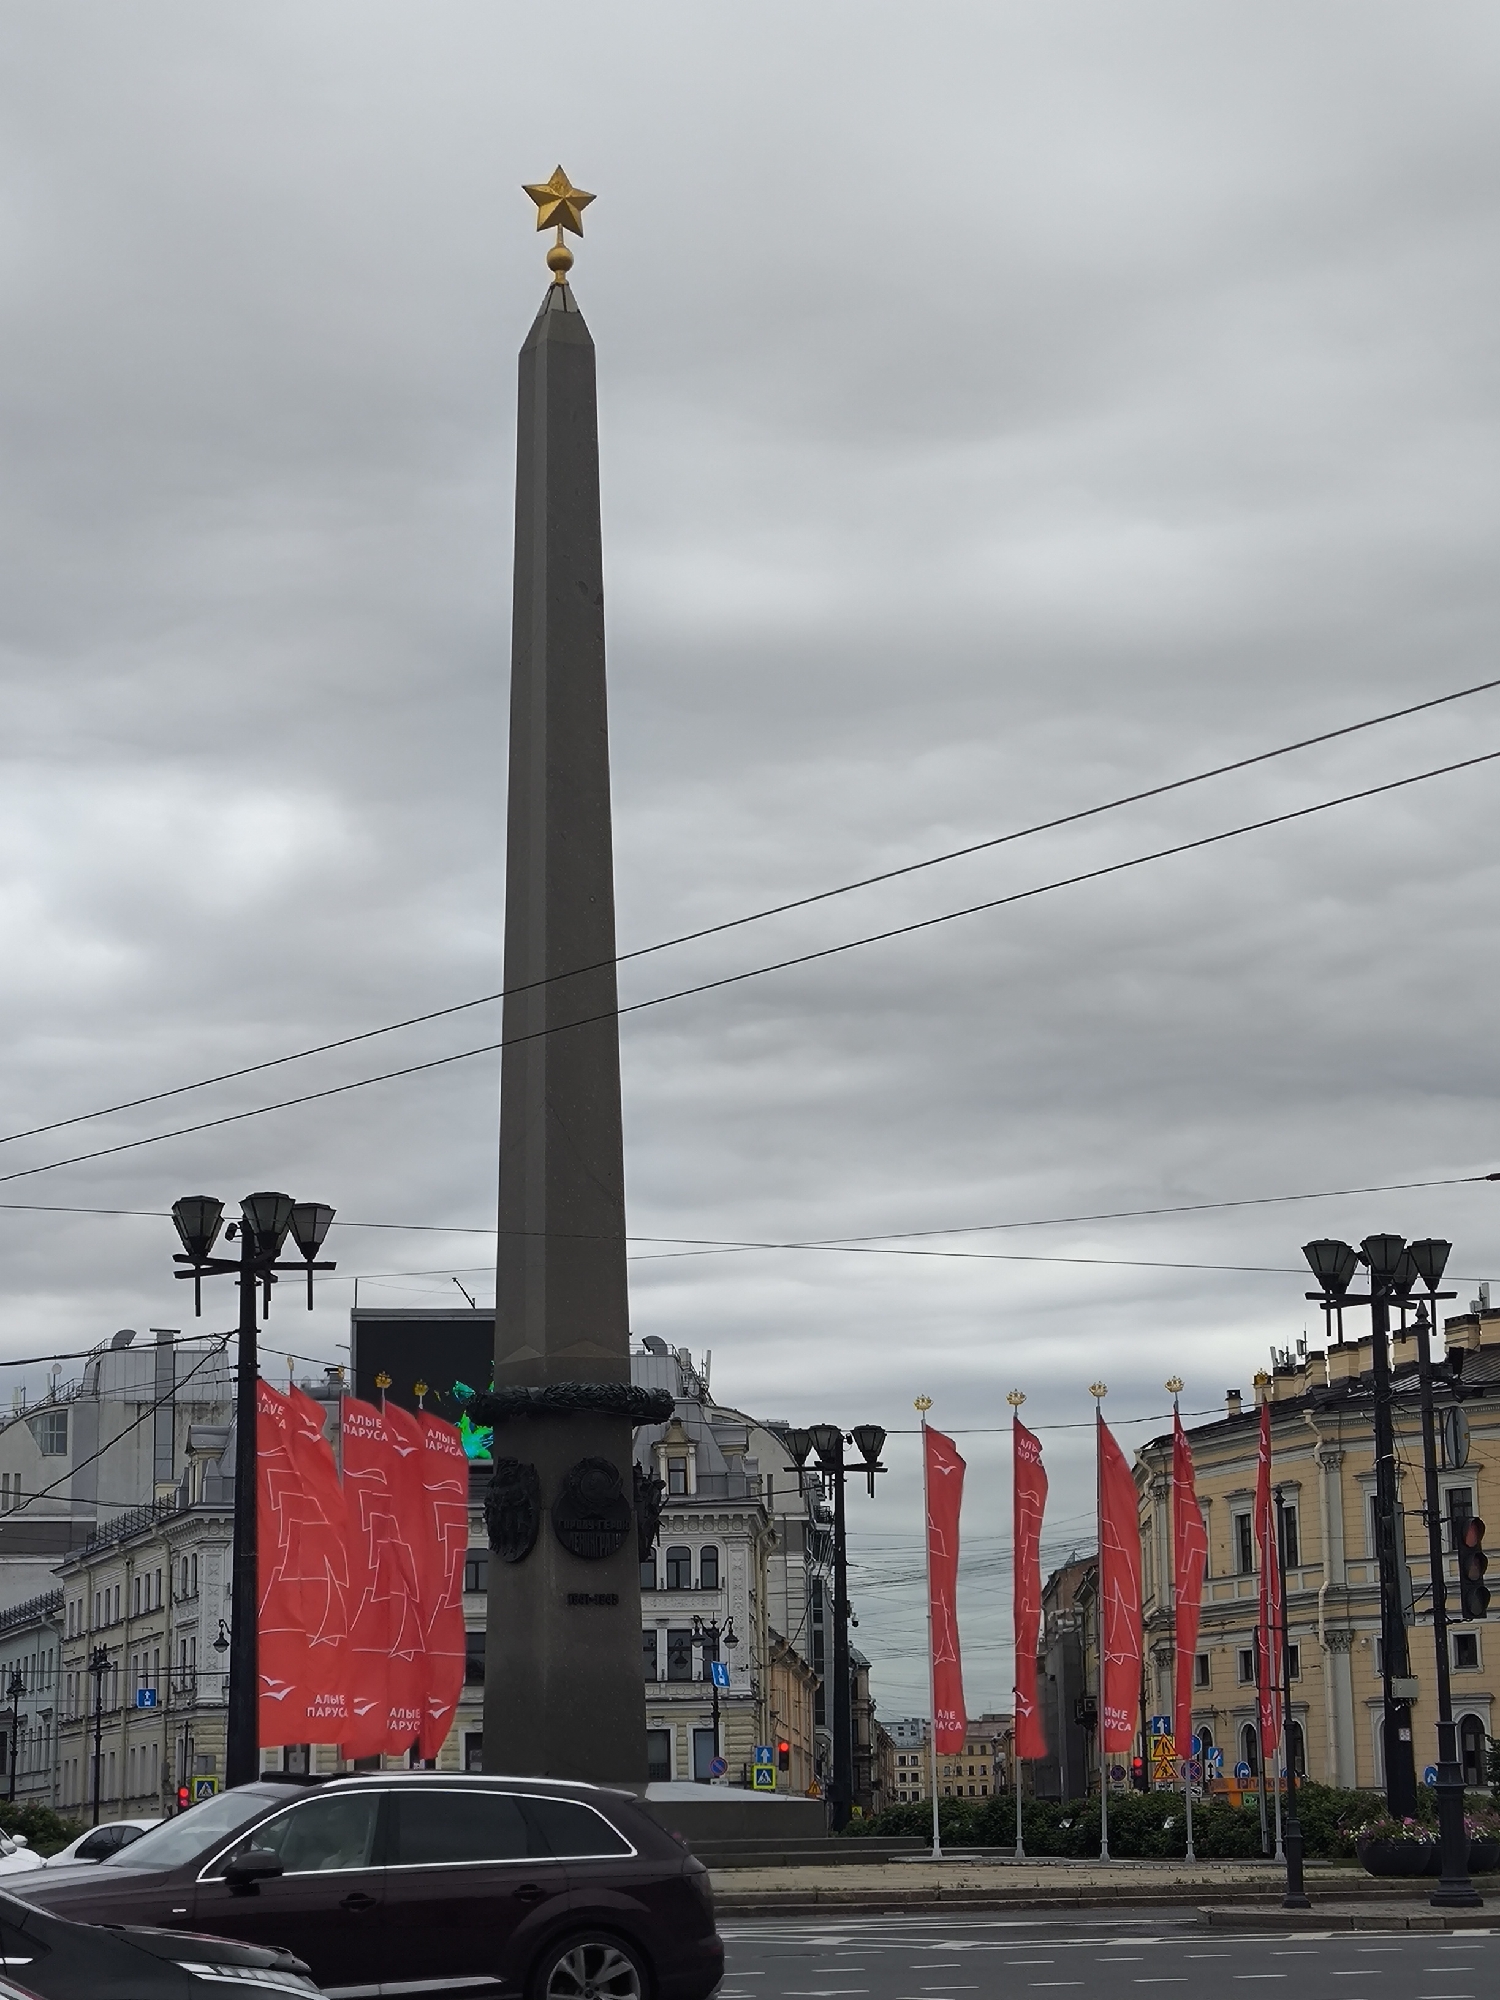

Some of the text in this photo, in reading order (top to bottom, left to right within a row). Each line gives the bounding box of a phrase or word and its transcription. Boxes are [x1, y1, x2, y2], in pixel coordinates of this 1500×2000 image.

[348, 1413, 383, 1429] АЛЫЕ
[343, 1423, 388, 1442] ПАРУСА
[427, 1428, 456, 1445] АЛЫЕ
[314, 1694, 345, 1705] АЛЫЕ
[390, 1707, 420, 1719] АЛЫЕ
[387, 1720, 420, 1733] АРУС
